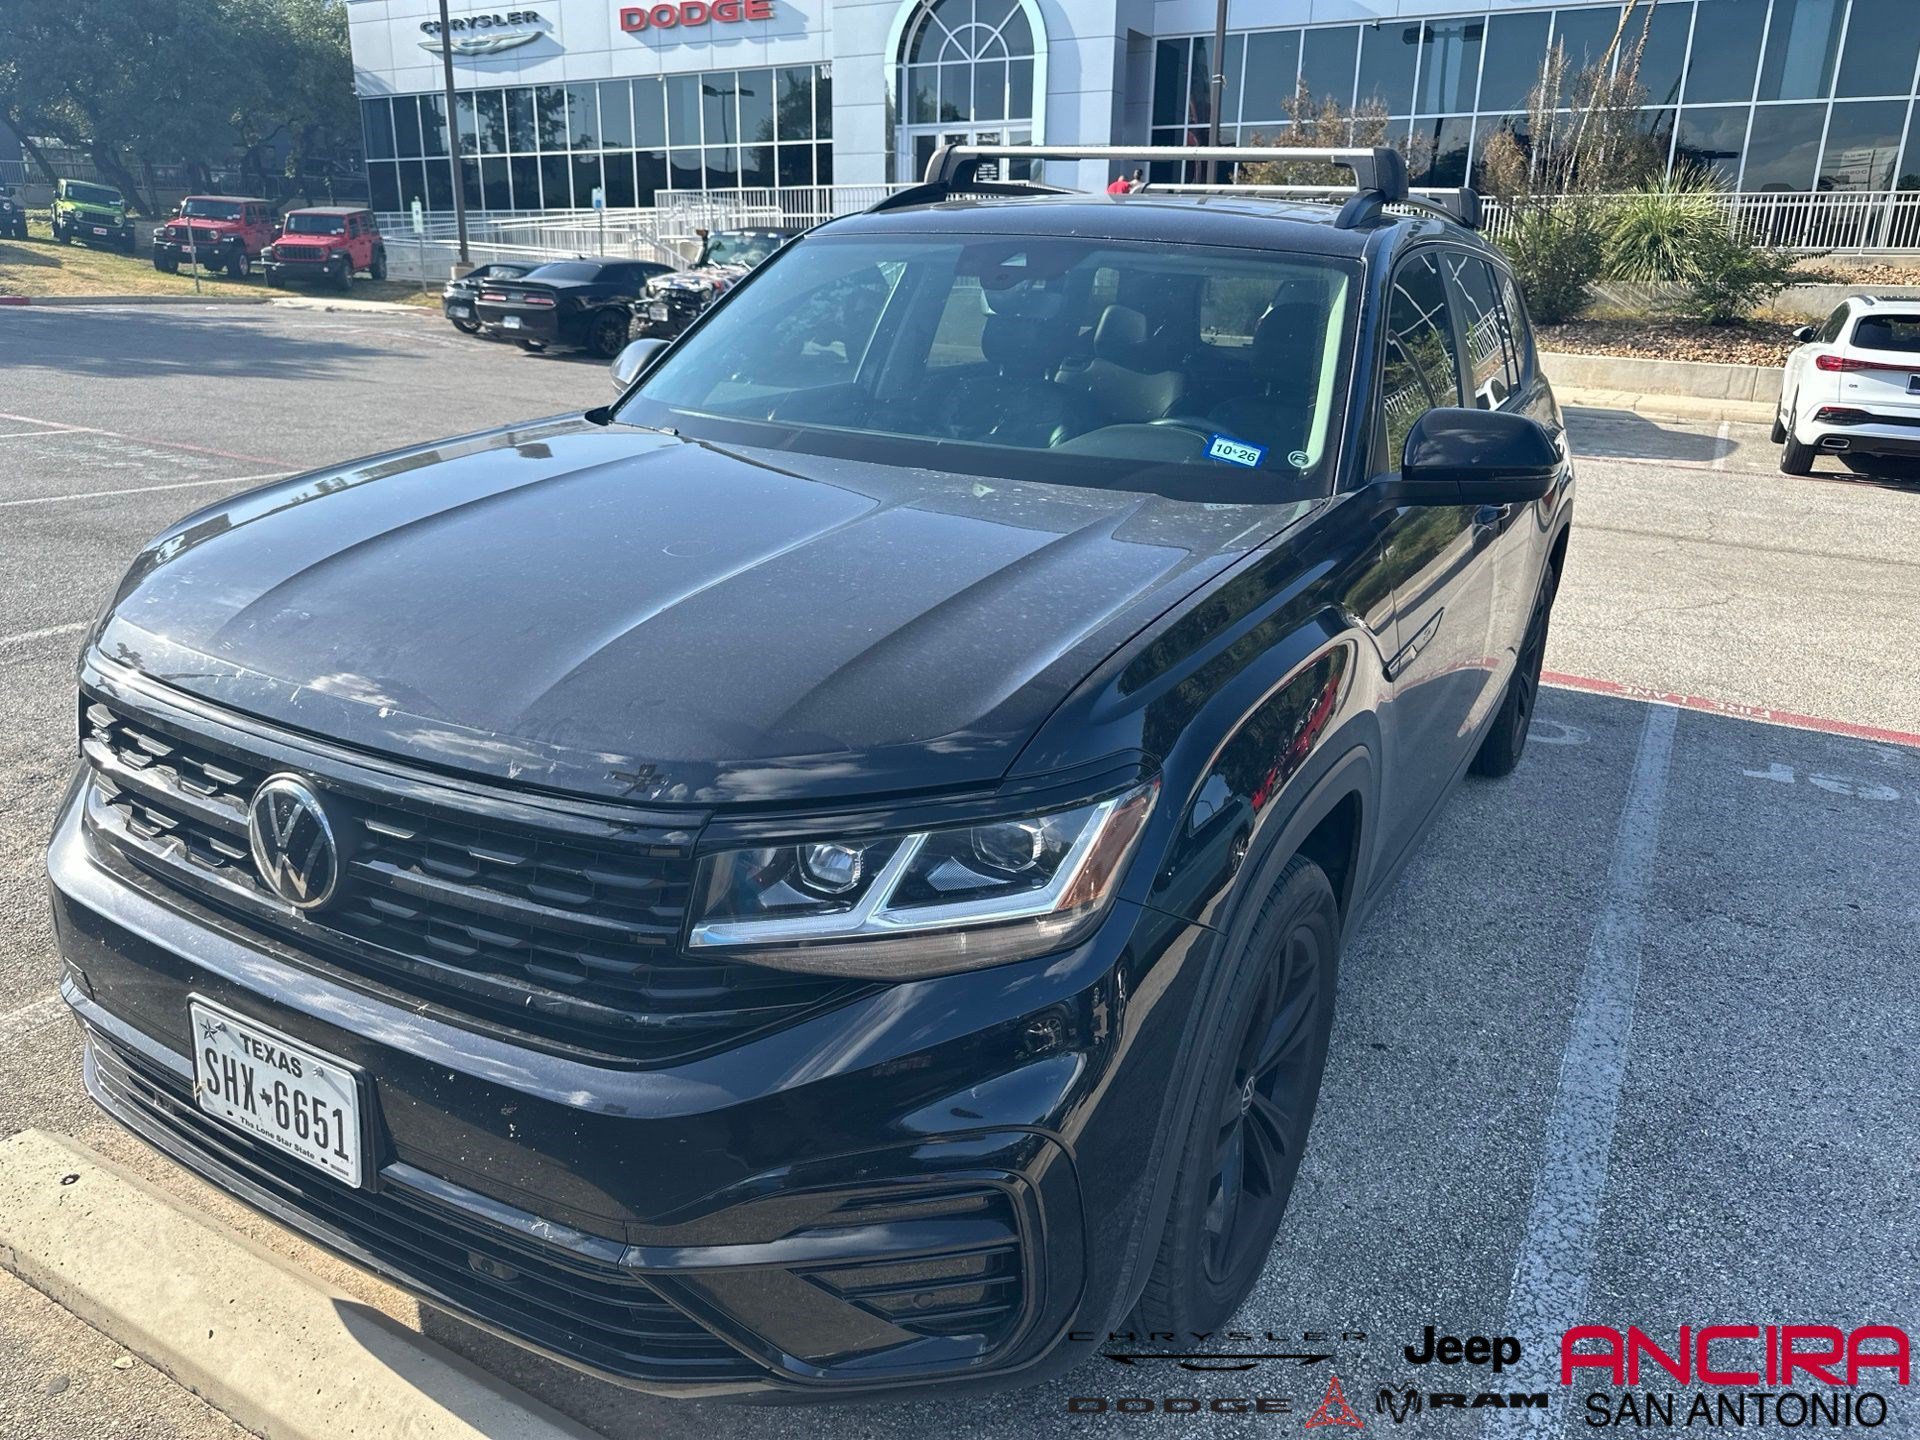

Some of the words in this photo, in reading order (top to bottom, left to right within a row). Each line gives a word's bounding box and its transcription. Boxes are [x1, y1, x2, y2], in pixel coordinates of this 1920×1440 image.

[620, 0, 774, 32] DODGE
[239, 1032, 303, 1078] TEXAS
[240, 1116, 254, 1129] The
[256, 1124, 275, 1139] Lone
[276, 1134, 292, 1149] Star
[294, 1143, 315, 1160] State
